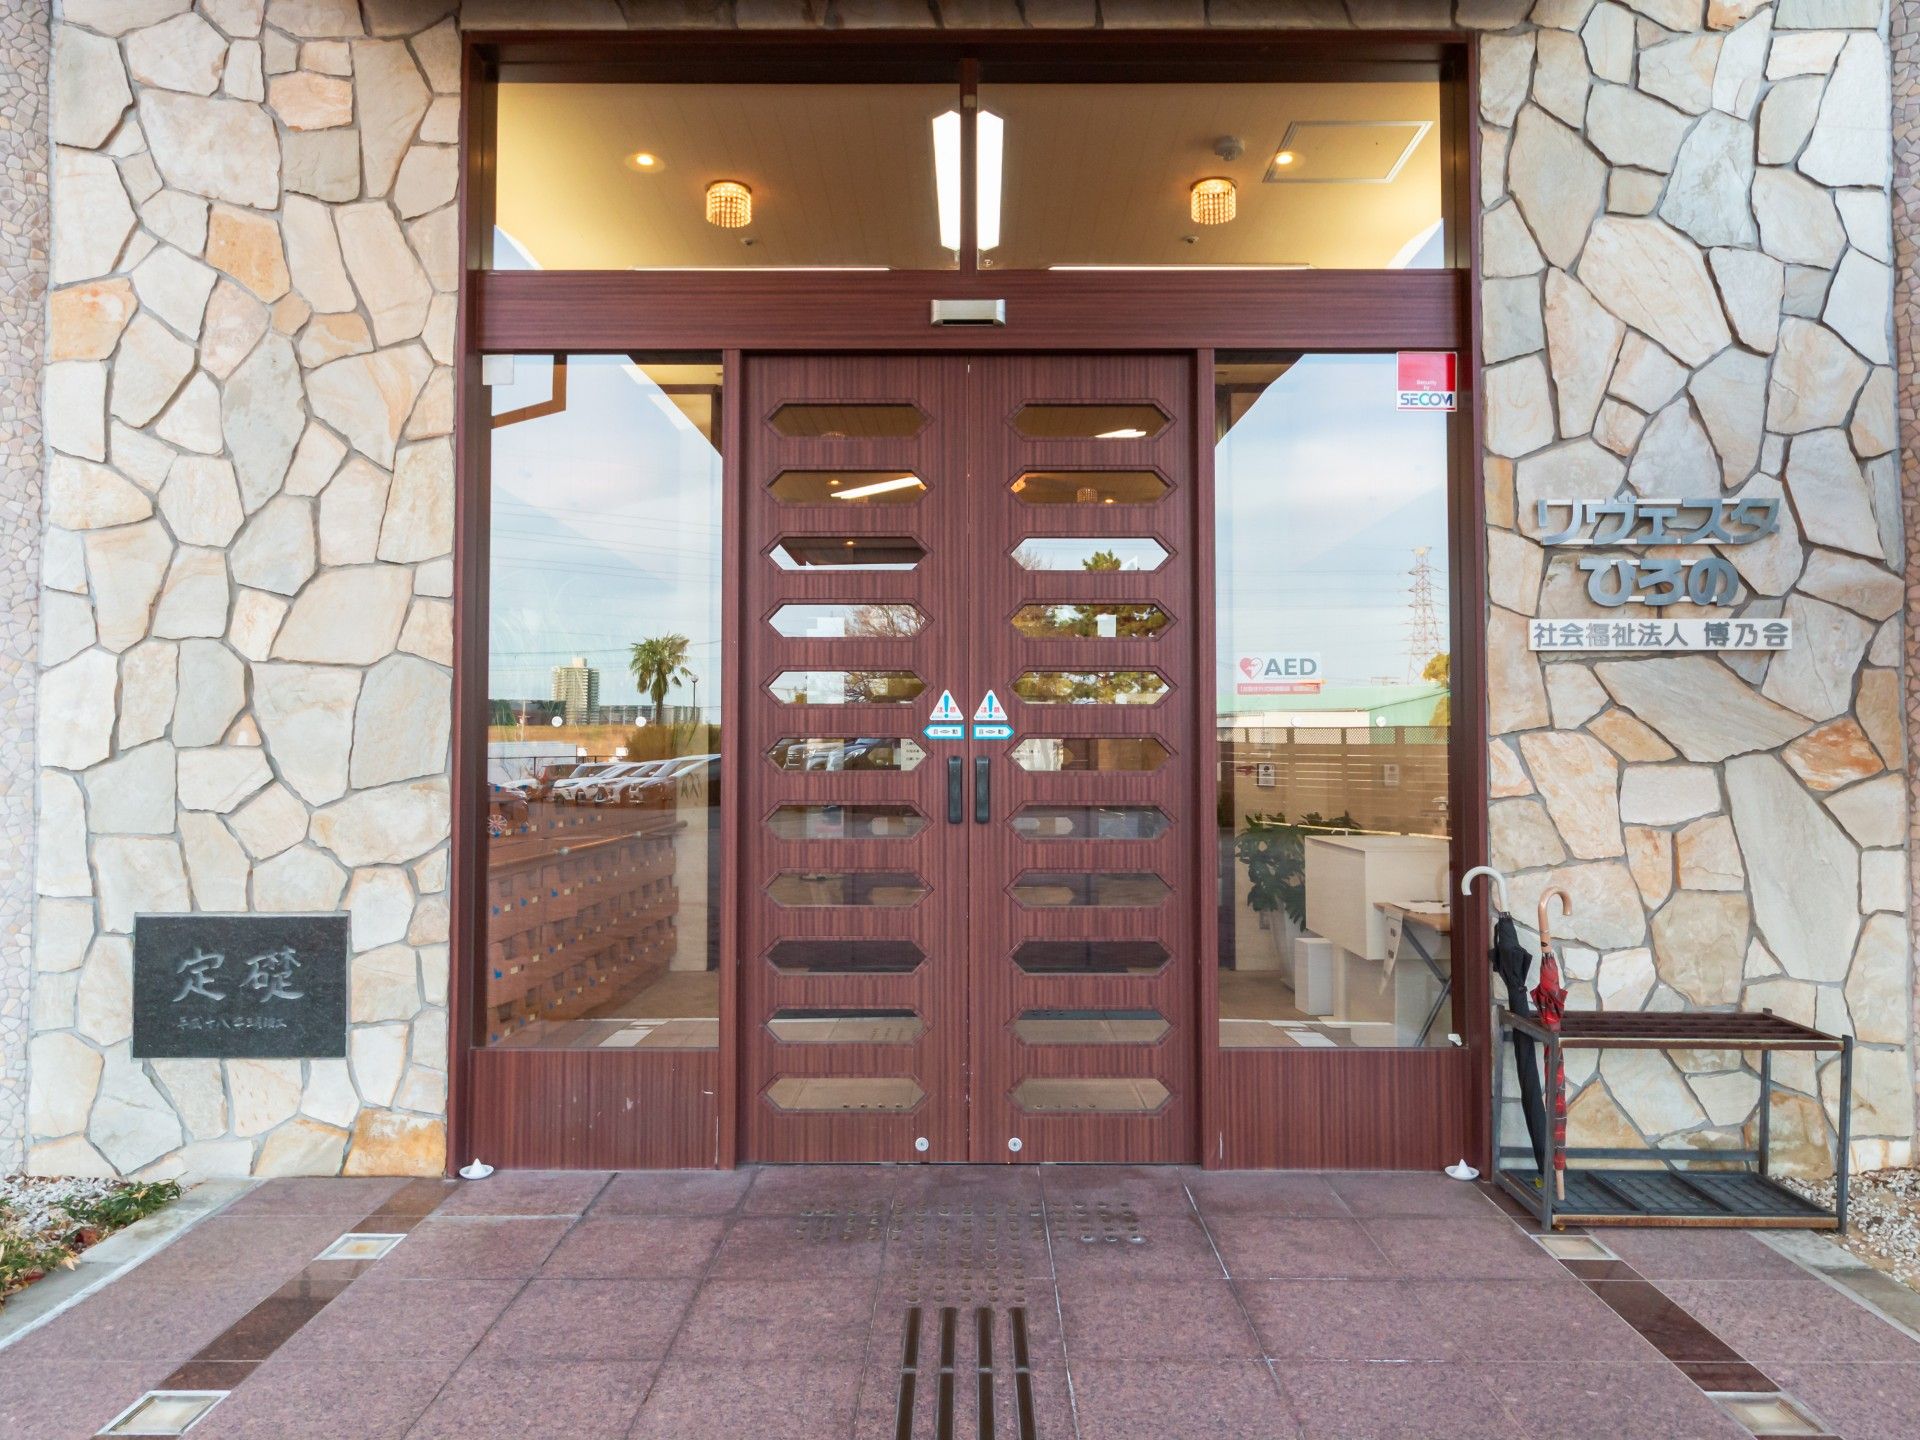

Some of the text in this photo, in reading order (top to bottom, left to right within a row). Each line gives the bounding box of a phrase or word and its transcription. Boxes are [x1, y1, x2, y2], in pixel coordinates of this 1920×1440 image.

[1400, 392, 1453, 406] SECOM
[1537, 494, 1780, 545] リヴェスタ
[1579, 558, 1739, 607] ひろの
[1534, 622, 1789, 648] 社会福祉法人 博乃会
[1264, 658, 1317, 676] AED
[172, 946, 305, 1003] 定礎
